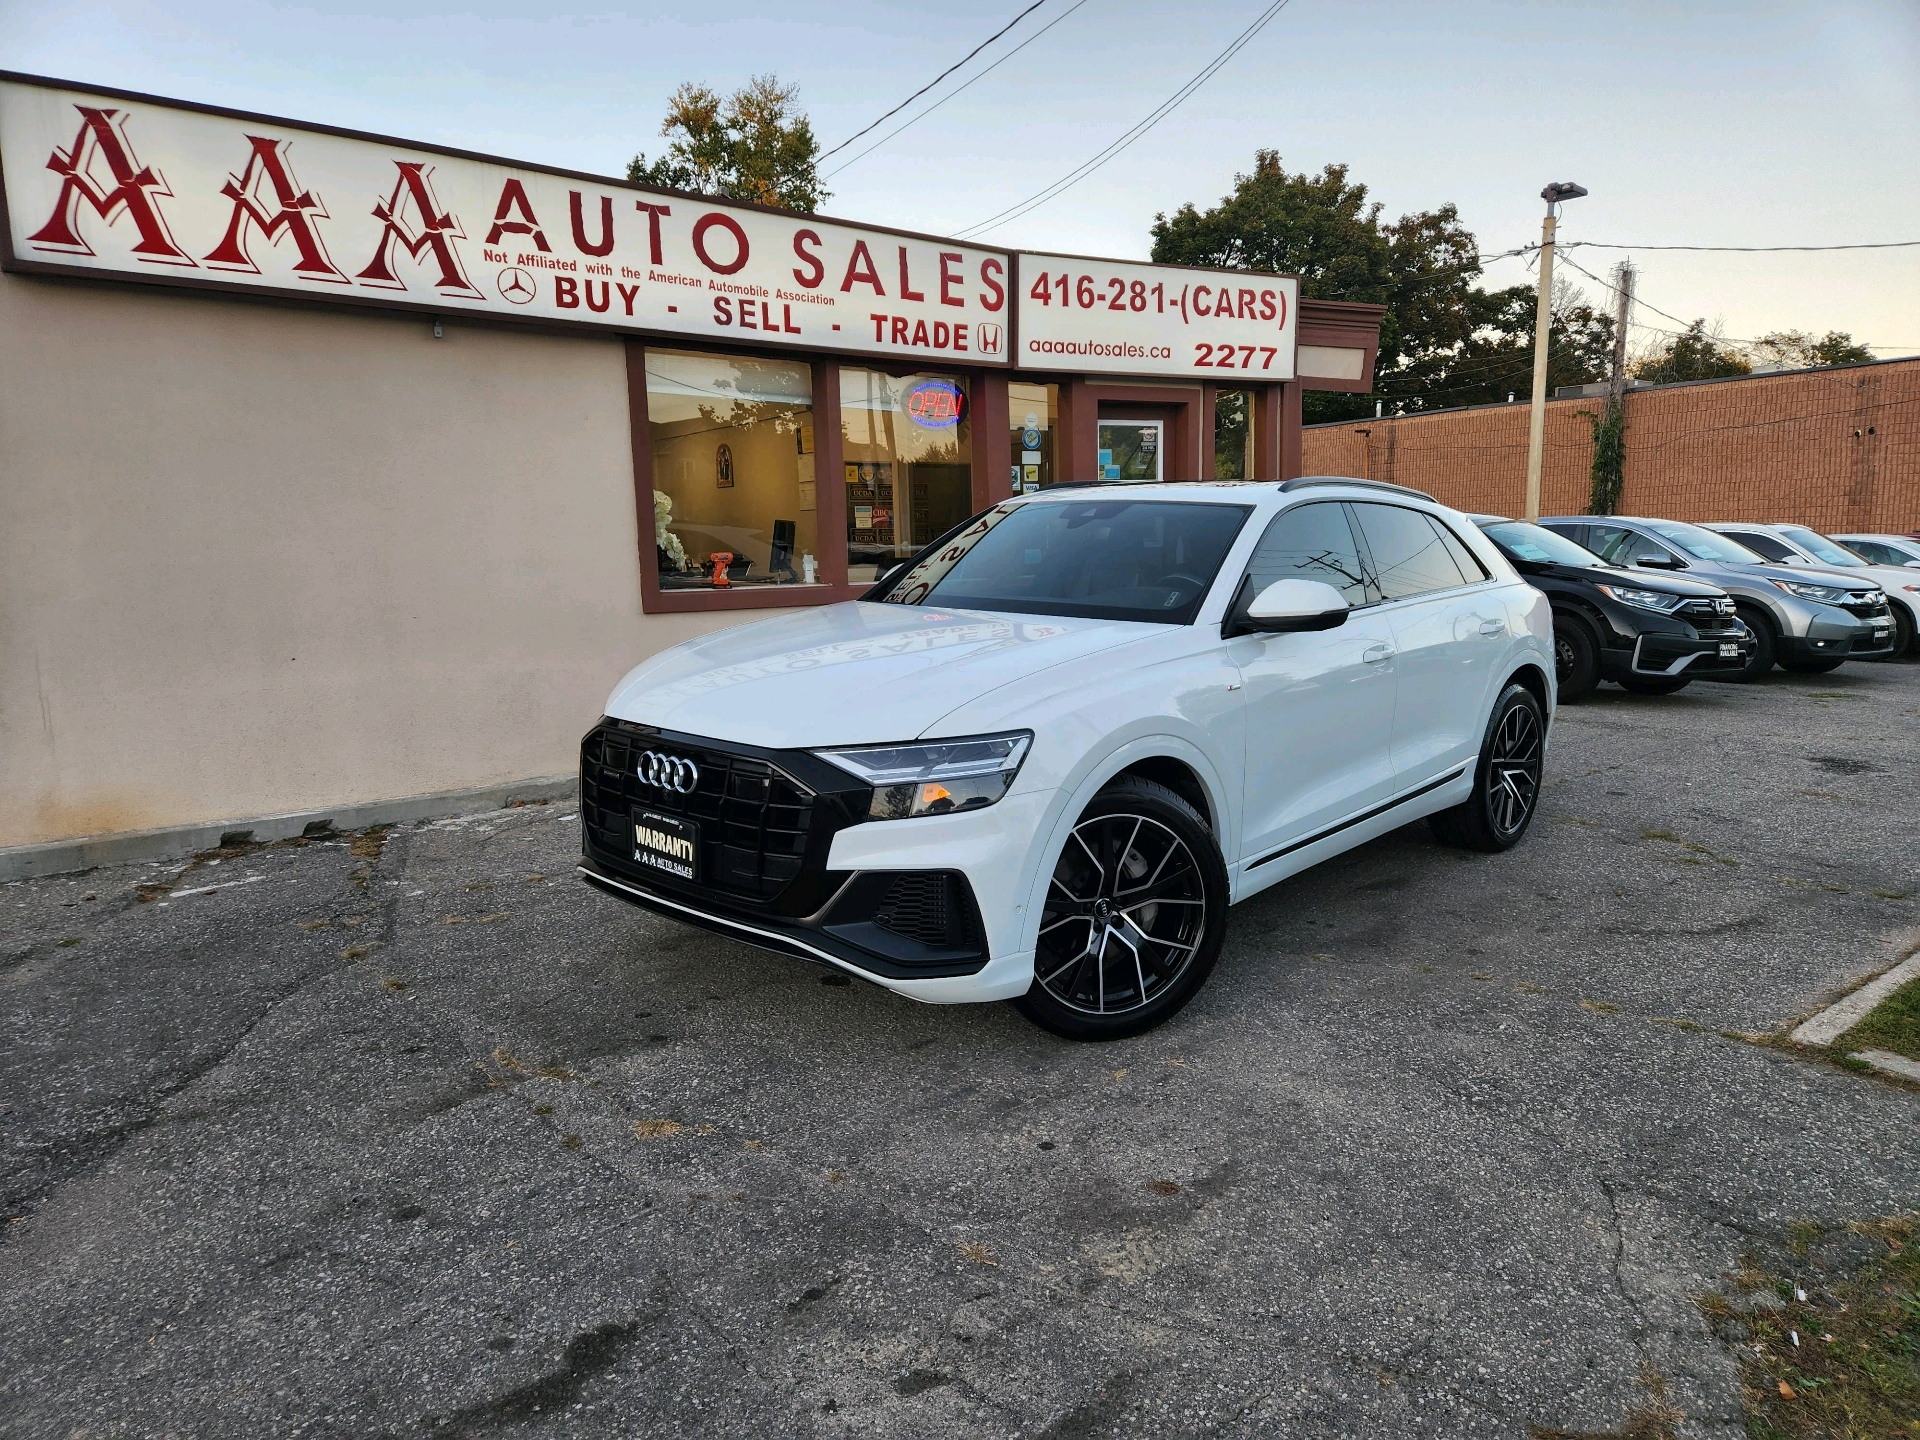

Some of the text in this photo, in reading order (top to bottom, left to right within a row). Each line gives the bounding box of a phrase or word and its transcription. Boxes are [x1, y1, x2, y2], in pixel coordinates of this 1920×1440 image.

[485, 178, 751, 276] AUTO
[792, 229, 1005, 312] SALES
[484, 249, 835, 306] Not Affiliated with the American Automobile Association
[1030, 271, 1287, 330] 416-281-(CARS)
[555, 276, 640, 317] BUY
[713, 296, 802, 335] SELL
[869, 313, 969, 352] TRADE
[1029, 339, 1278, 370] aaaautosales.ca 2277
[908, 391, 964, 417] OPEN
[635, 824, 693, 862] WARRANTY
[657, 857, 673, 869] AUTO
[673, 862, 693, 876] SALES
